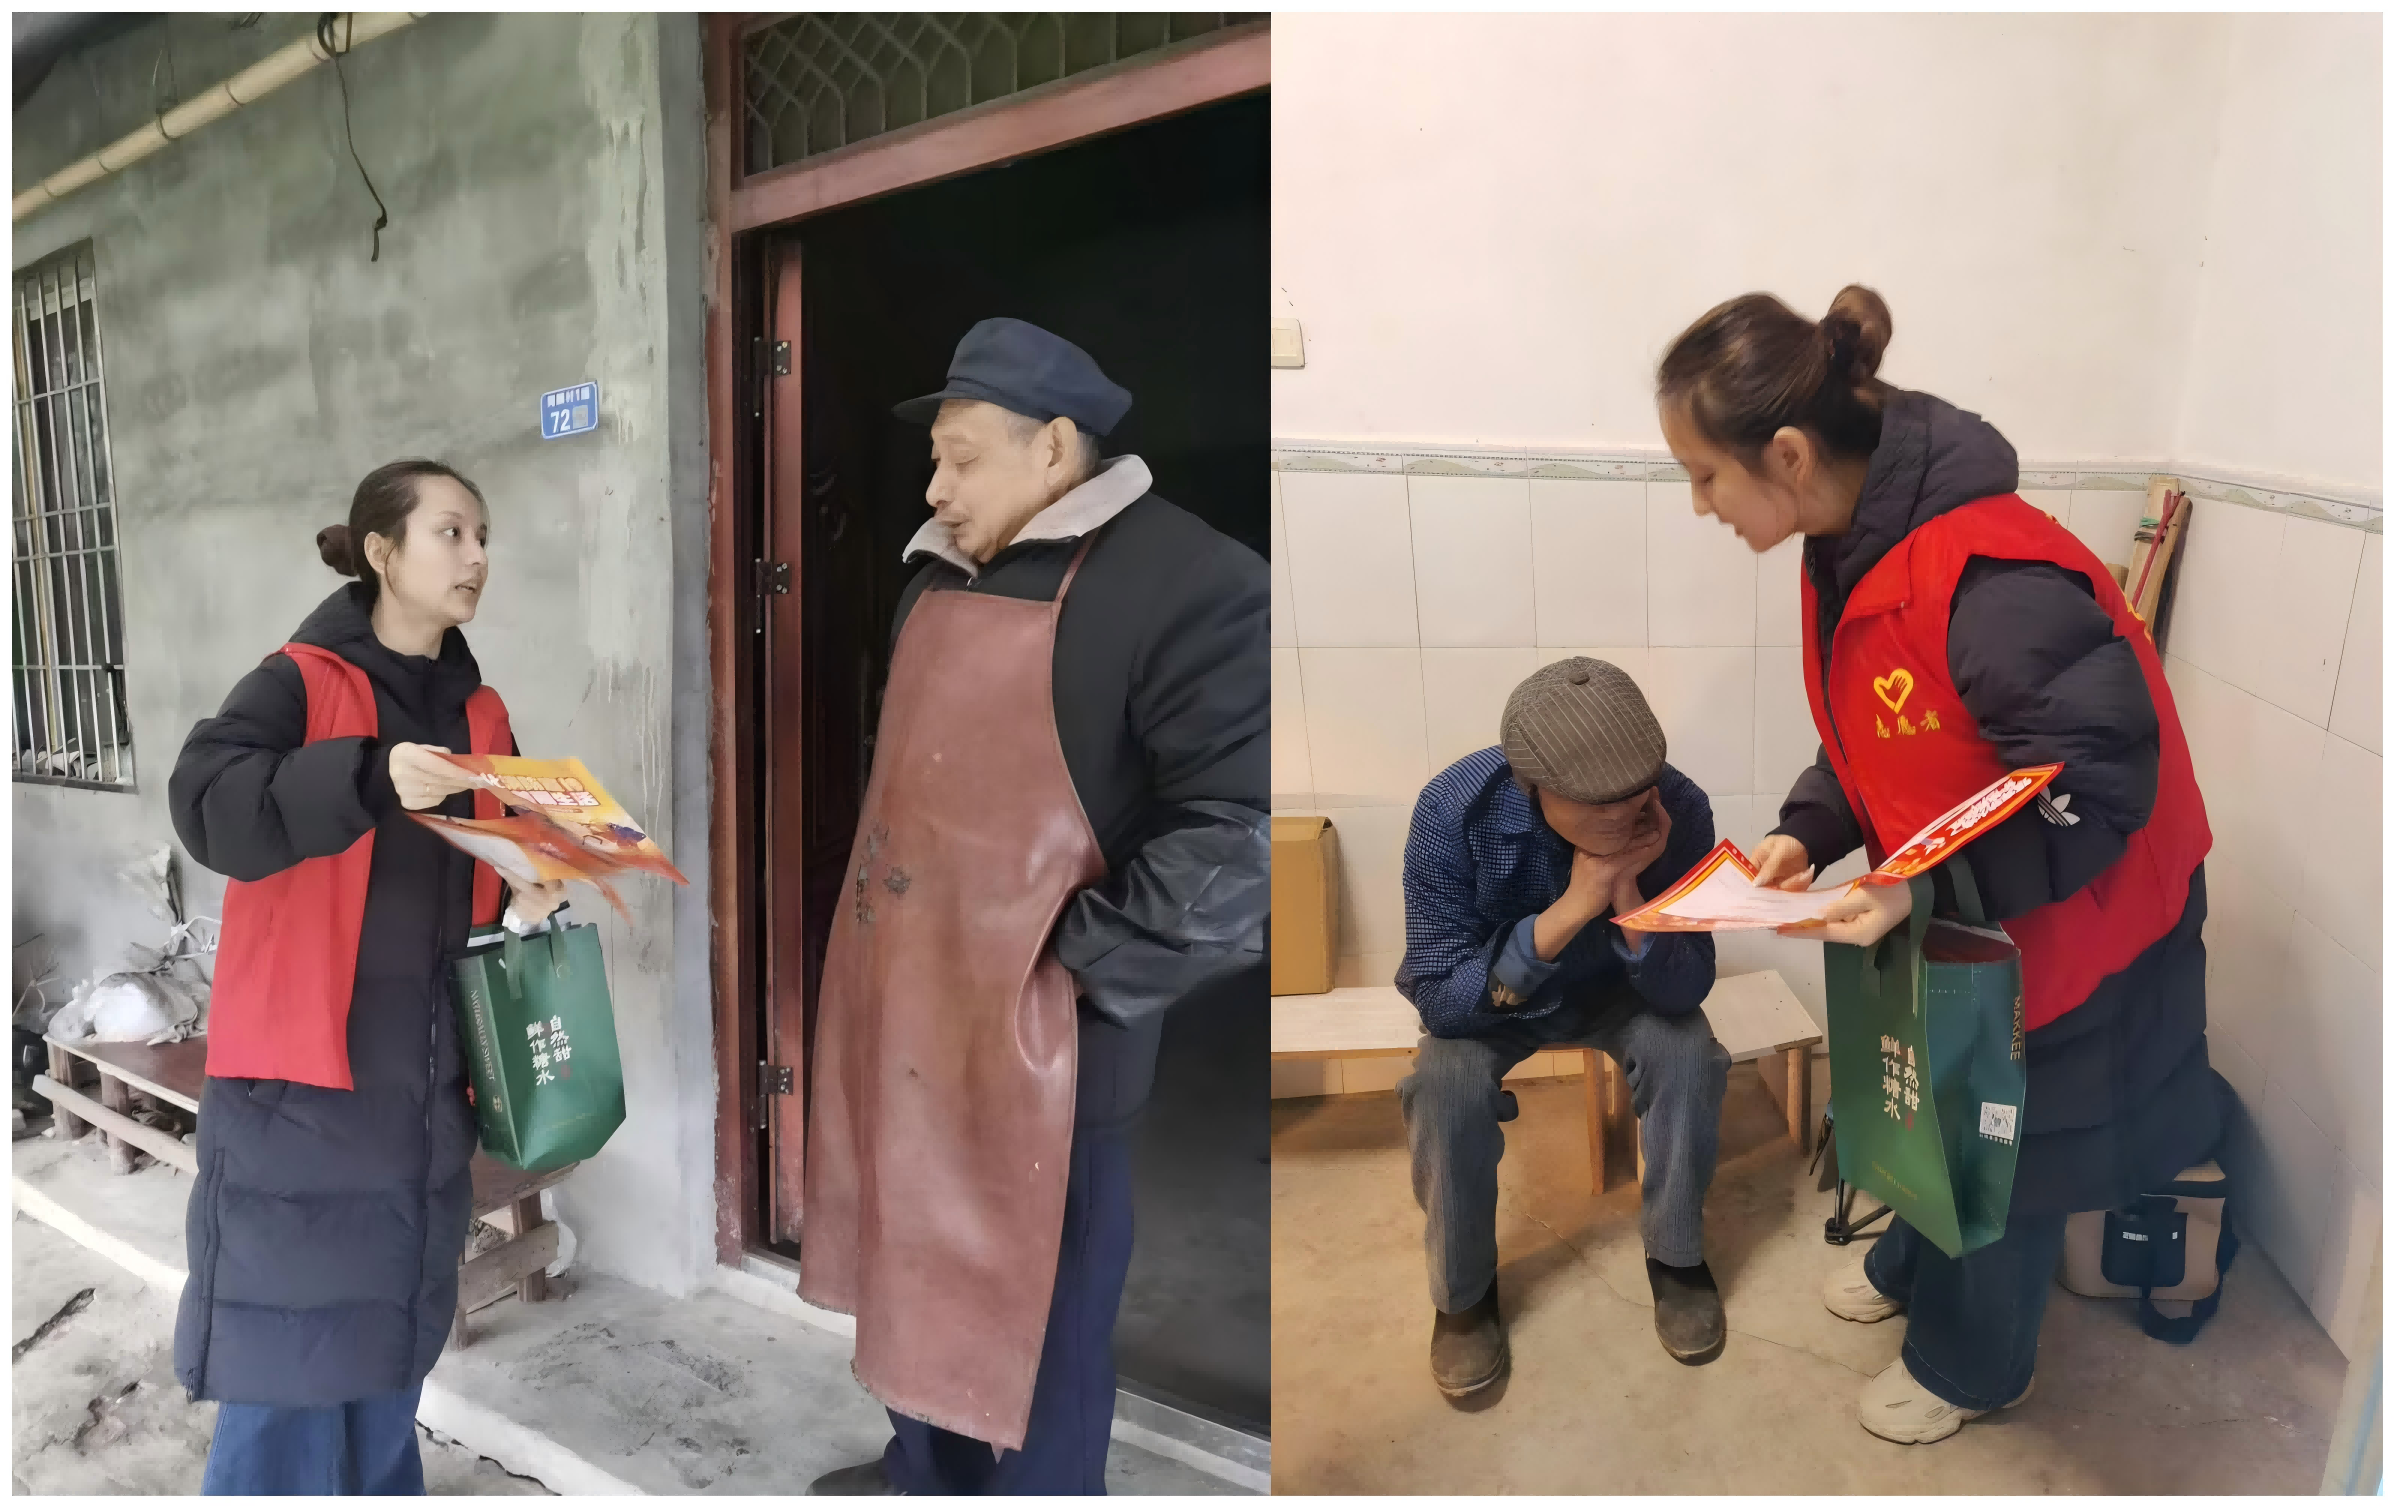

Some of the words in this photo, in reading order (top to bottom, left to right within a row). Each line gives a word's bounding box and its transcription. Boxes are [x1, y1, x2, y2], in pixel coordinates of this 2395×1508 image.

[550, 409, 571, 433] 72
[550, 1014, 572, 1063] 自然甜
[2010, 995, 2021, 1061] MAKKEE
[1904, 1045, 1920, 1111] 自然甜
